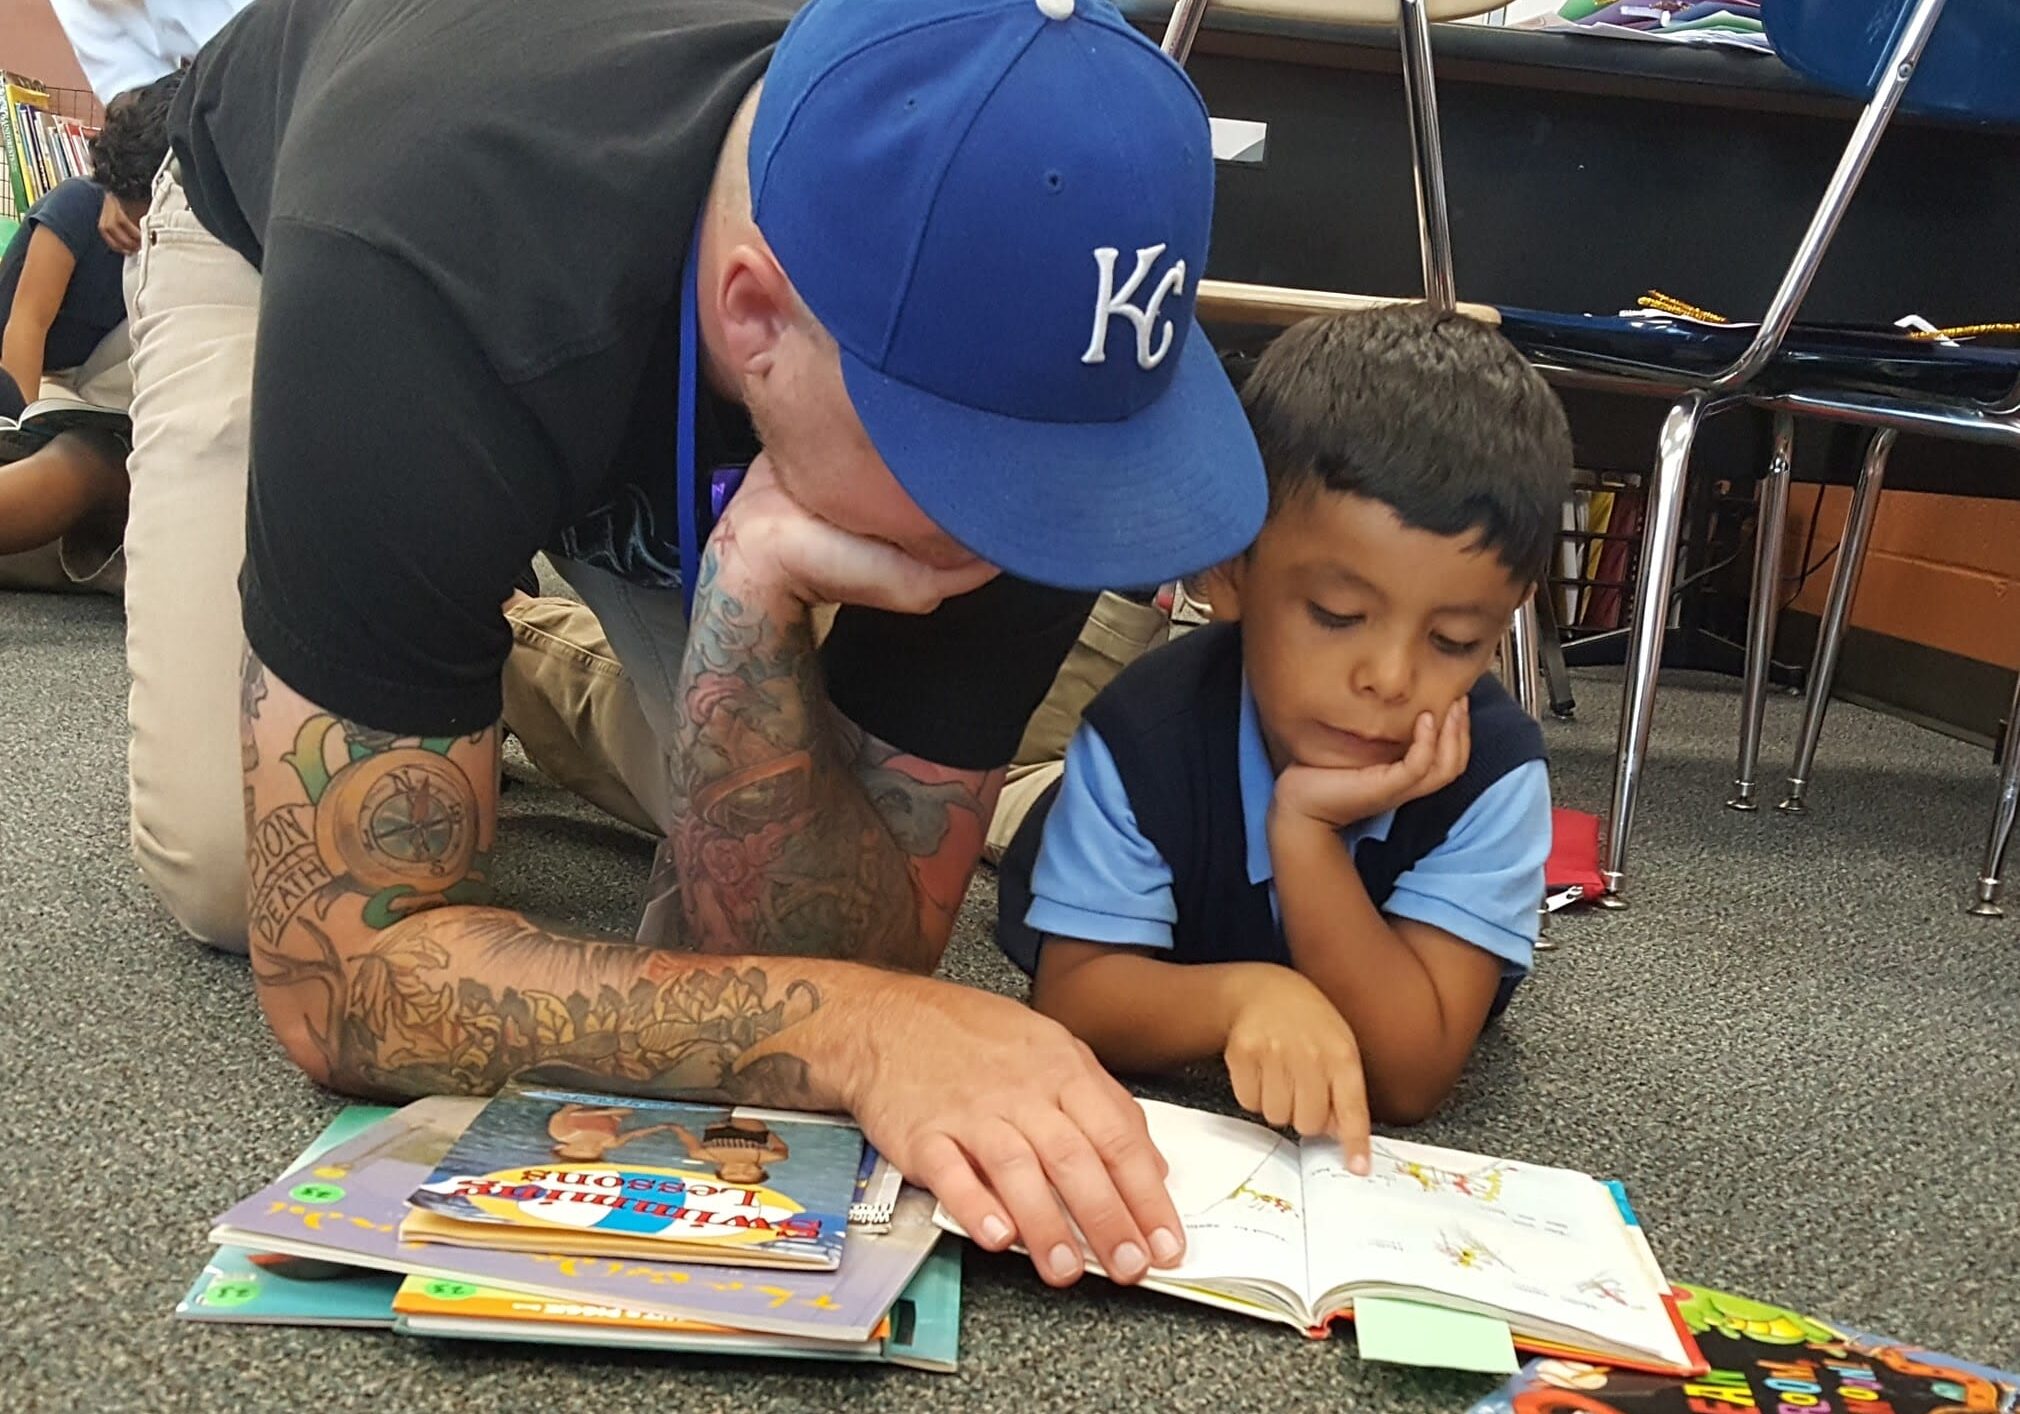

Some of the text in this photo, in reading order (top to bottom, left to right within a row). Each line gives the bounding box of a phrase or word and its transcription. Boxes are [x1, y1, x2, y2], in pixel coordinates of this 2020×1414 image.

[1081, 243, 1186, 370] KC
[258, 859, 327, 944] DEATH
[453, 1179, 822, 1239] Swimming
[521, 1169, 763, 1208] Lessons
